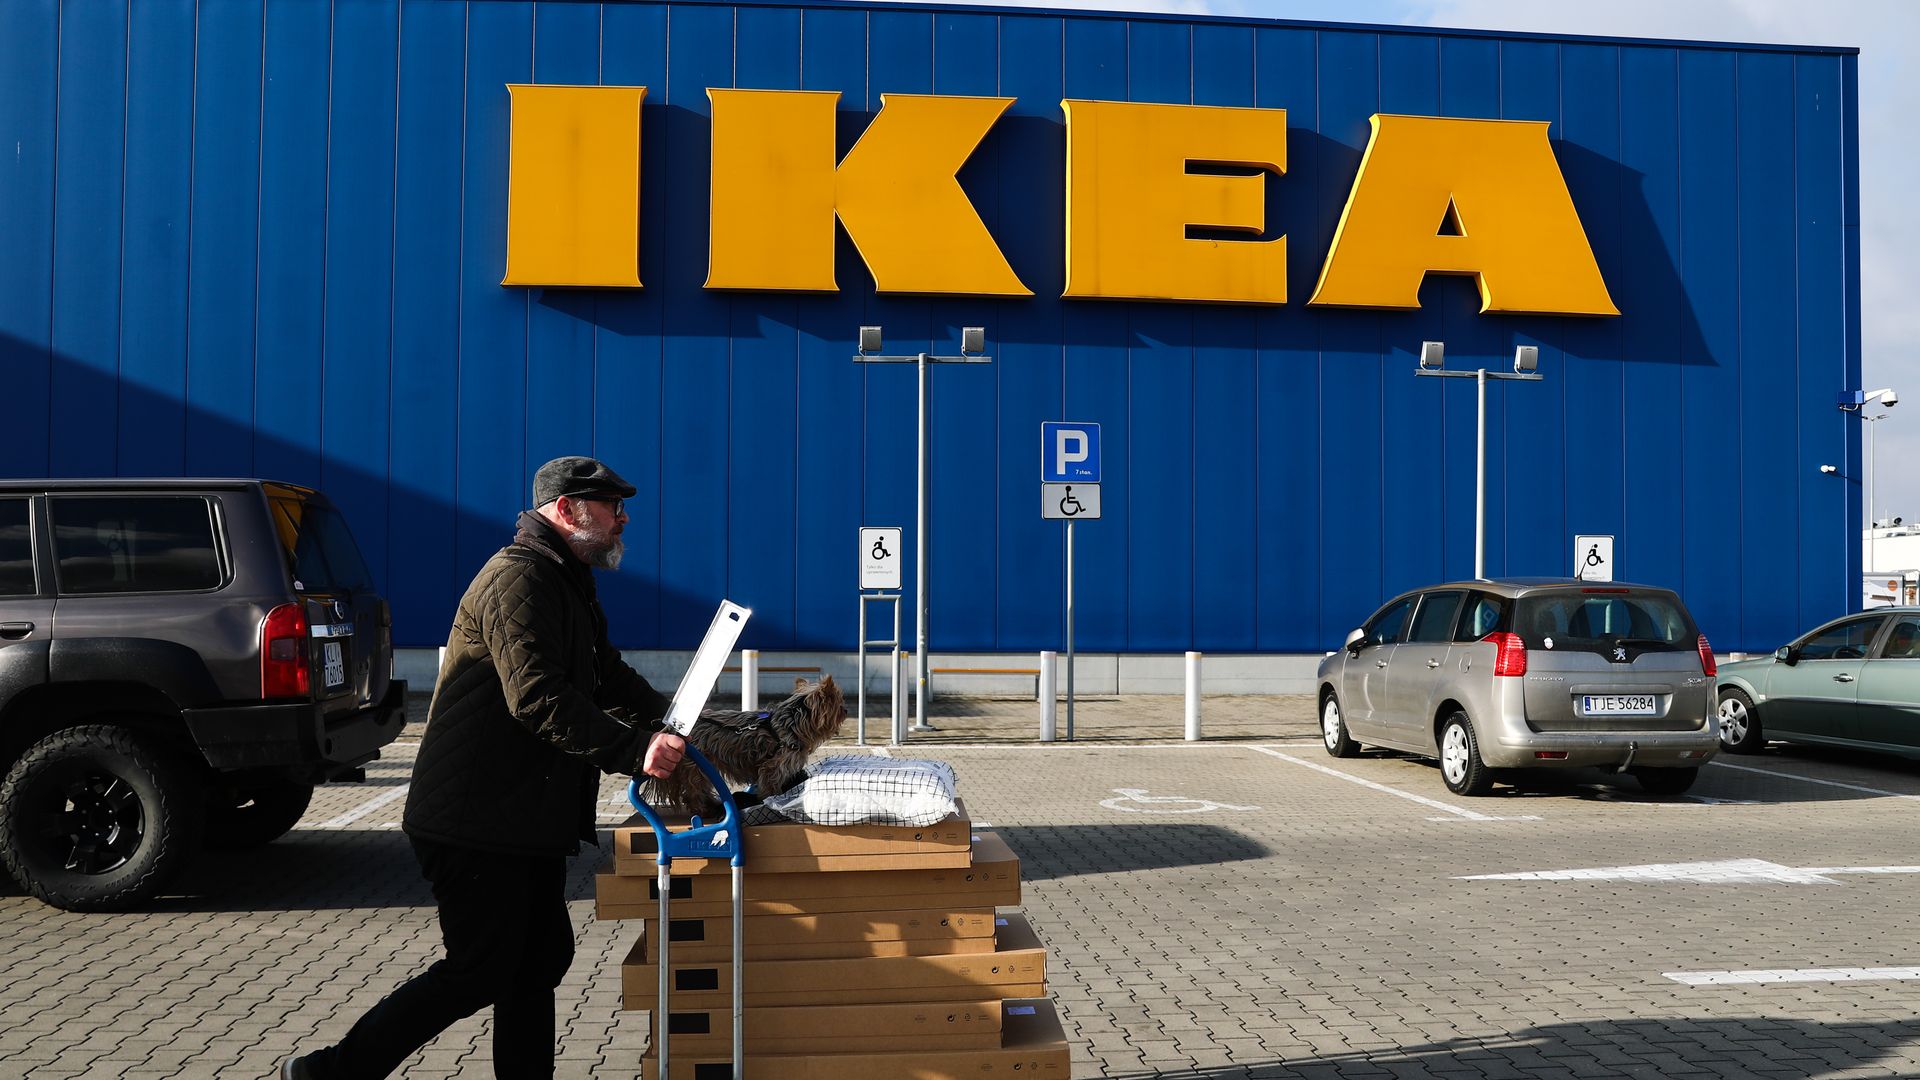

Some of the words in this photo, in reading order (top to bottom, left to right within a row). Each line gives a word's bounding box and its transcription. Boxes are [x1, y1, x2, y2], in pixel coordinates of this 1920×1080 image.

[501, 83, 1622, 317] IKEA
[1056, 429, 1088, 475] P
[325, 664, 344, 685] 76015
[1591, 697, 1614, 710] TJE
[1618, 697, 1654, 710] 56284
